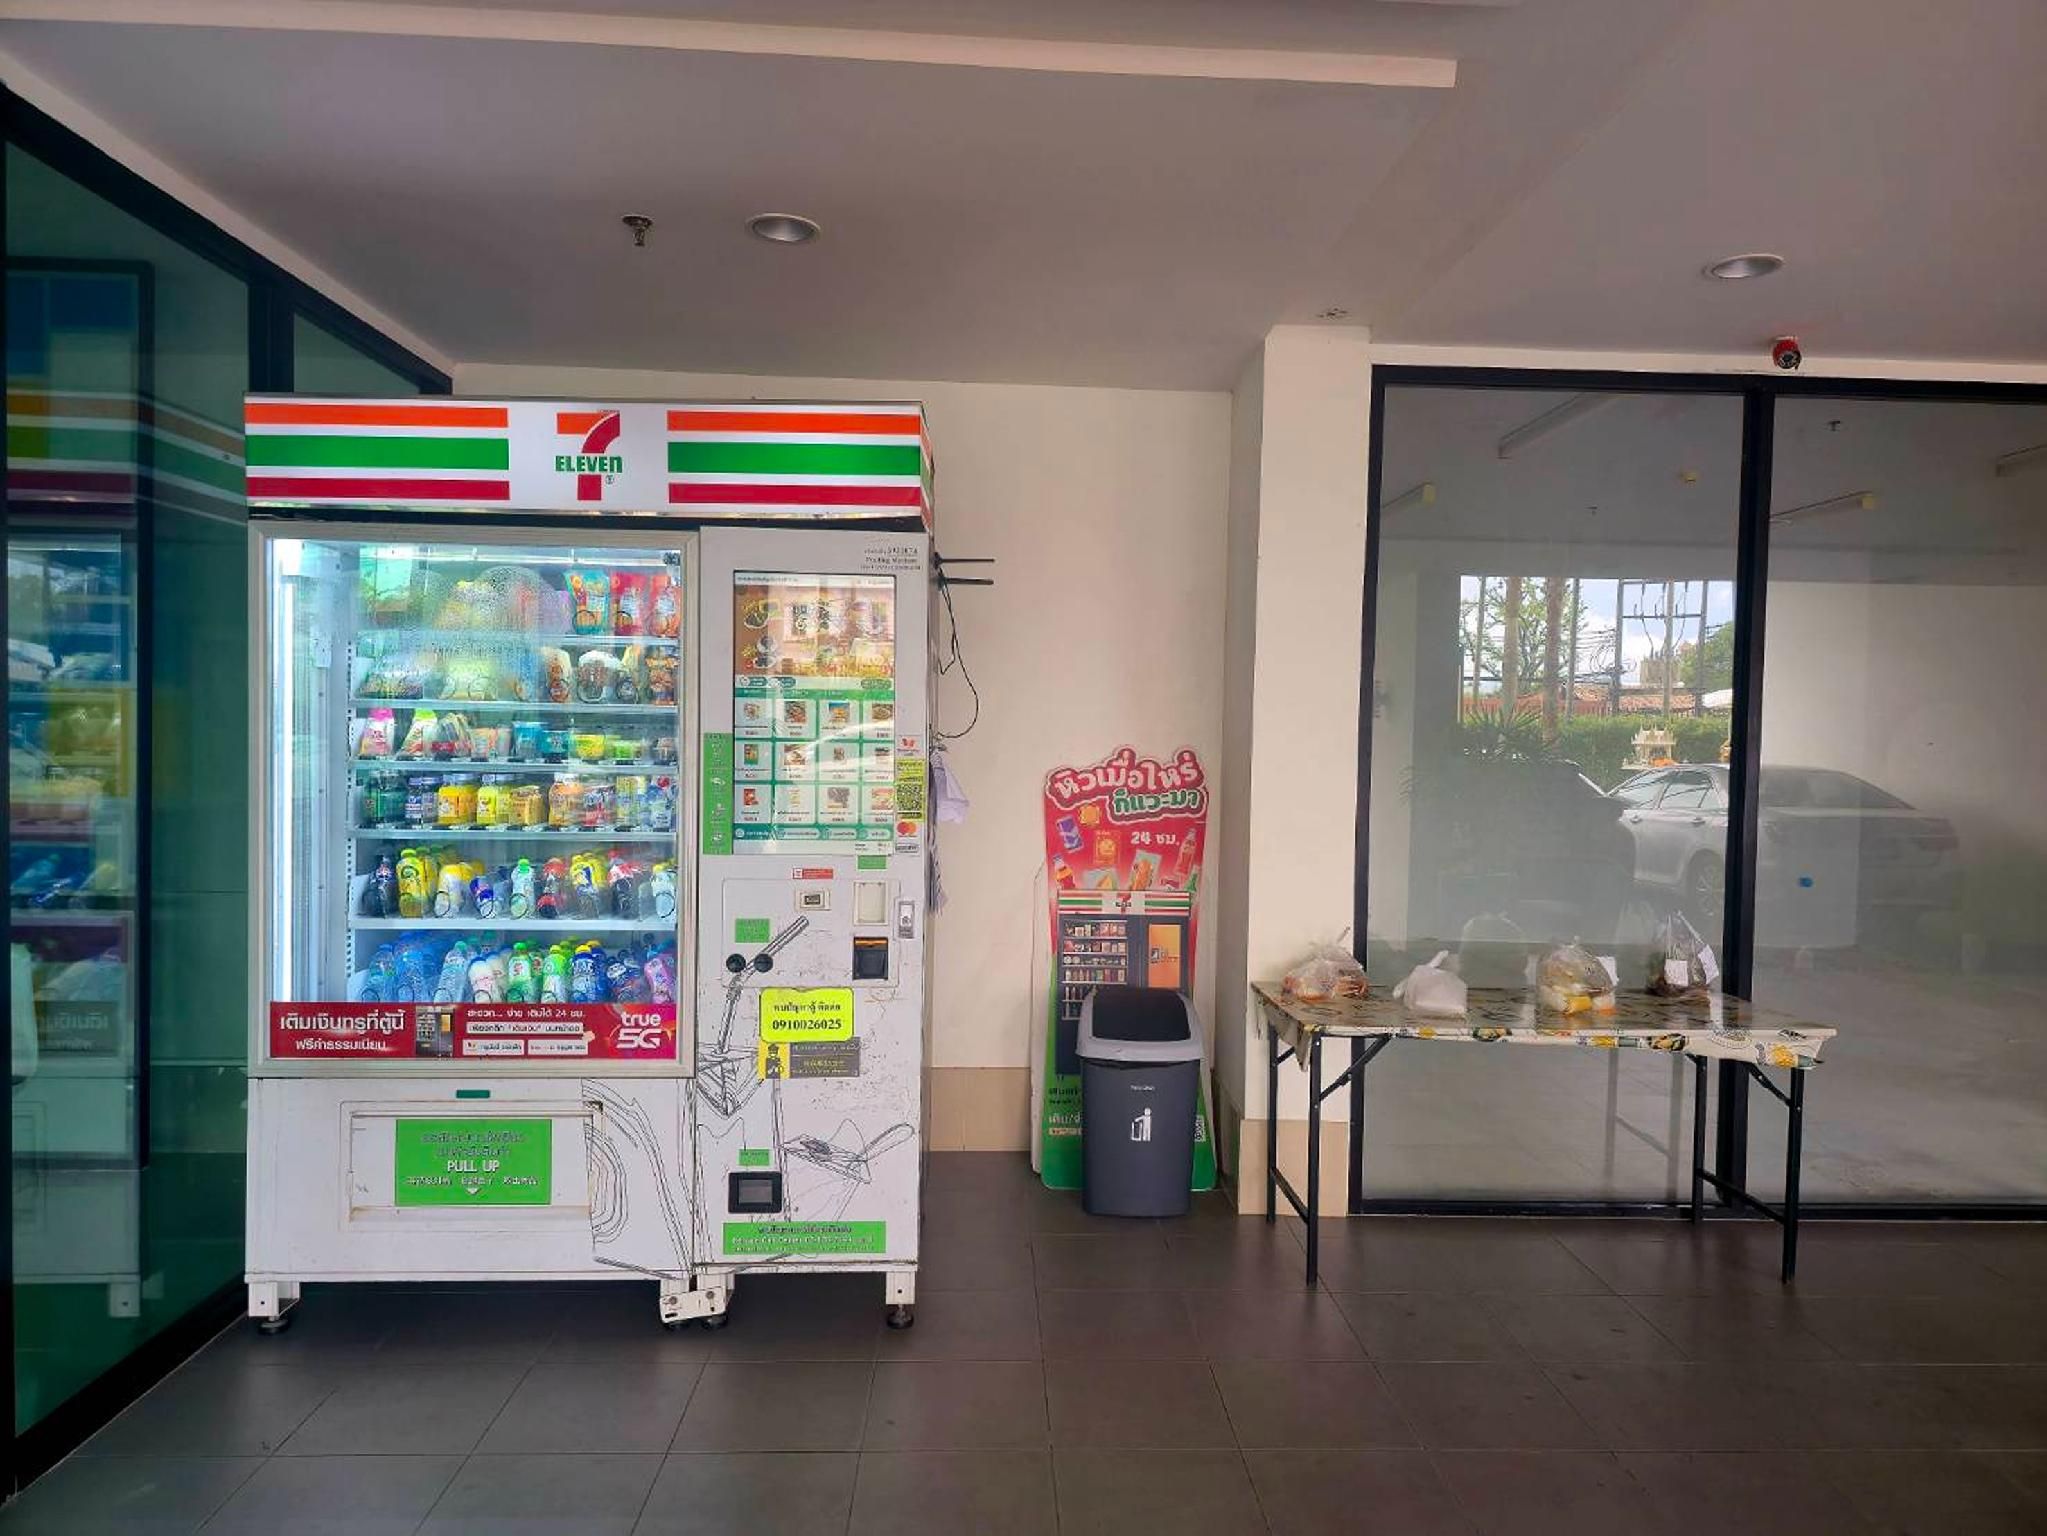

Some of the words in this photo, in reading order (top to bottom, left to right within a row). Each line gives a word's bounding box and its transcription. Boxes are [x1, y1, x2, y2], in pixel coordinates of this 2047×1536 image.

[557, 412, 620, 500] 7
[1131, 831, 1152, 845] 24
[555, 1009, 567, 1018] 24
[621, 1012, 661, 1026] true
[280, 1009, 406, 1035] เติมเงินทรูที่ตู้นี้
[616, 1028, 662, 1049] 5G
[447, 1159, 478, 1173] PULL
[482, 1159, 500, 1173] UP
